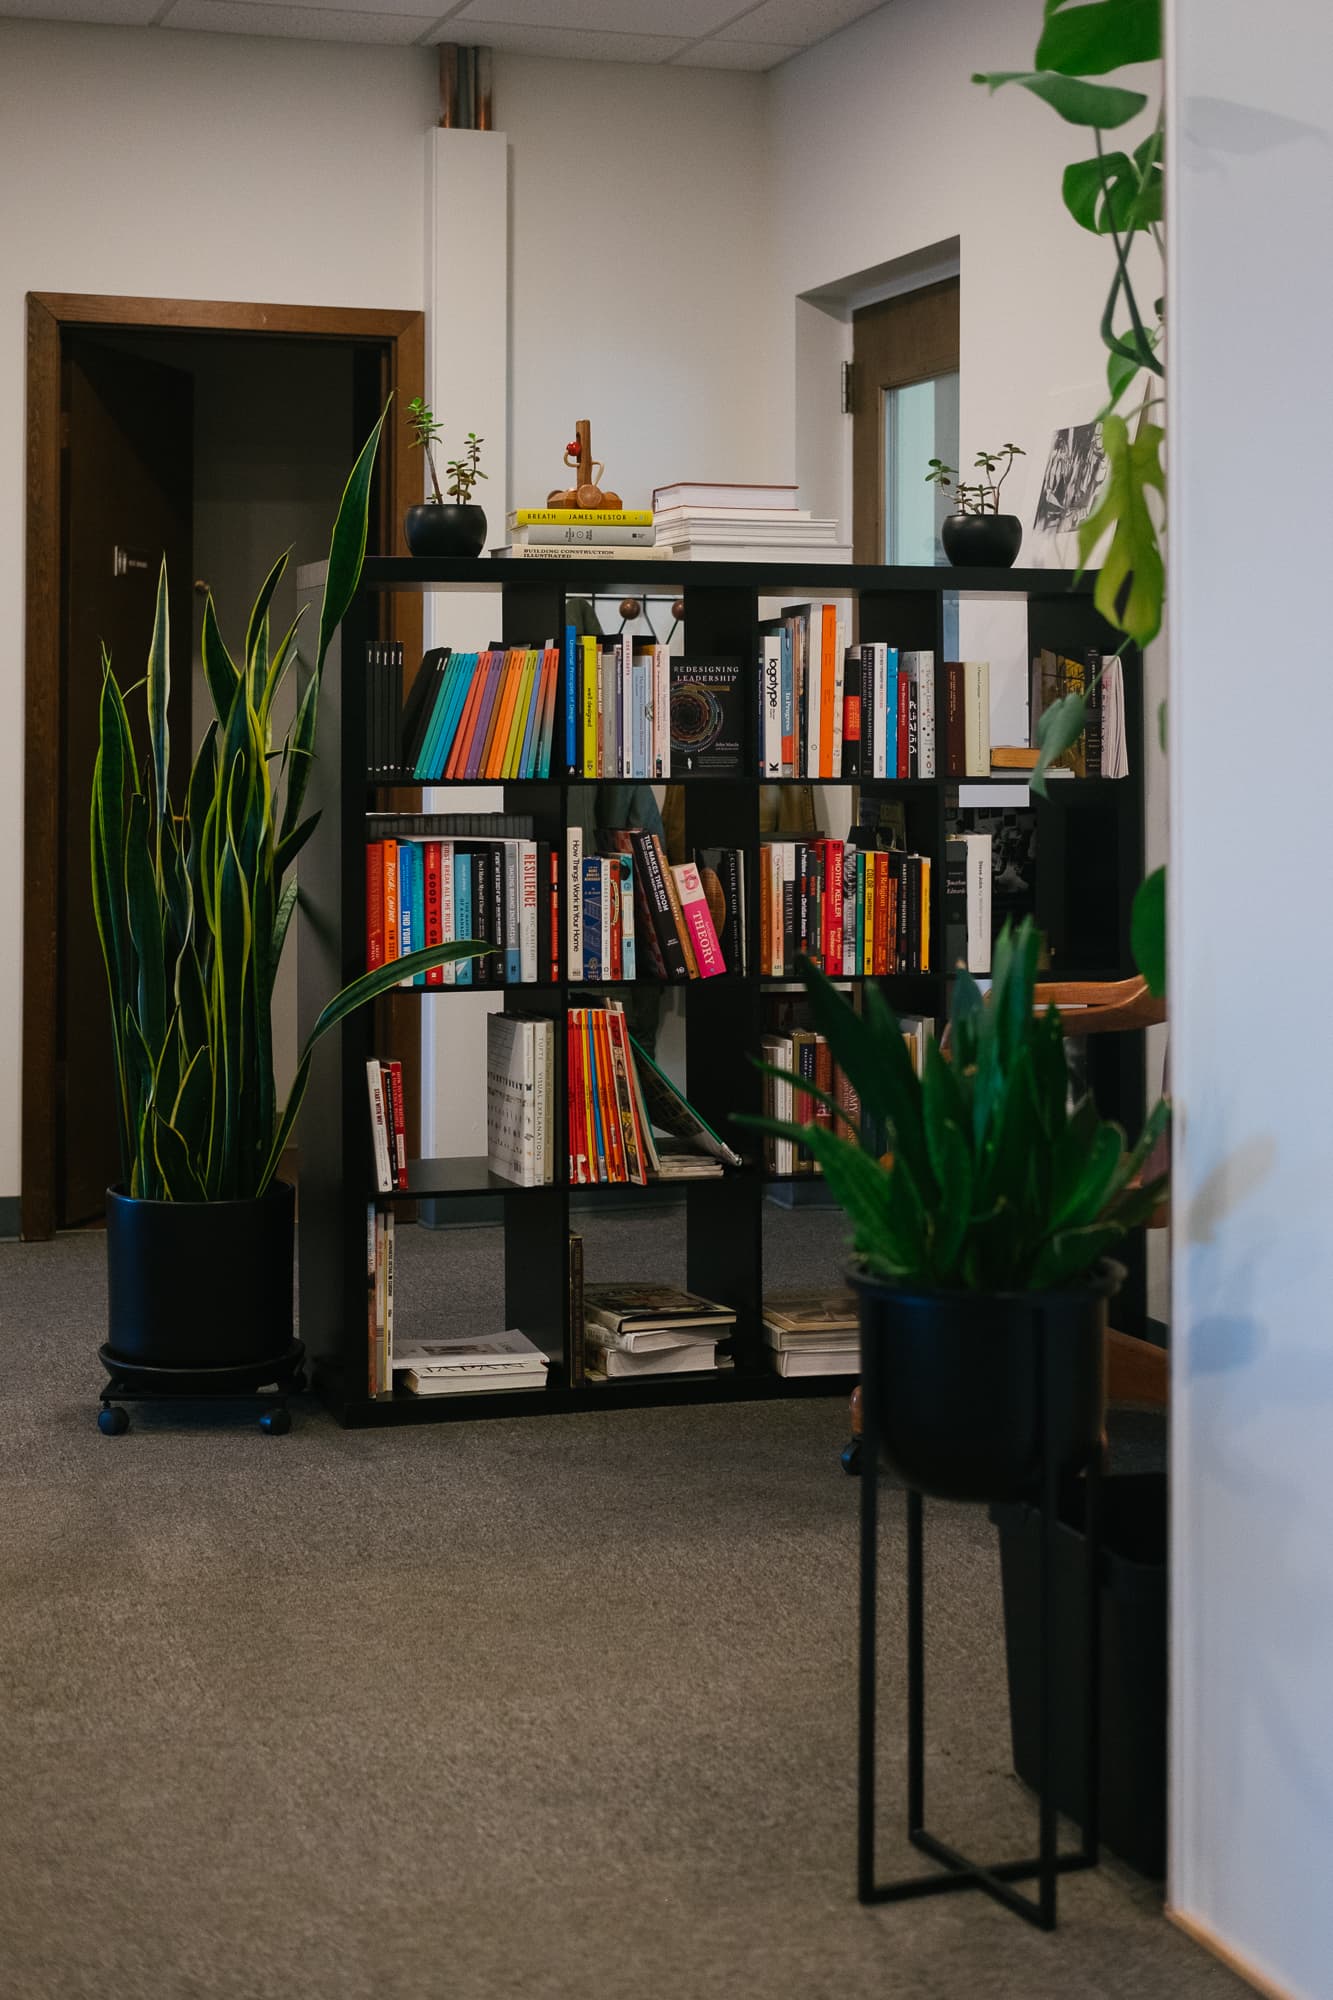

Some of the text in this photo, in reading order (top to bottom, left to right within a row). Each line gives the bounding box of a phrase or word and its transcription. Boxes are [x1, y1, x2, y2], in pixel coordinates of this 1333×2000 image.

[673, 665, 740, 673] REDESIGNING
[766, 658, 779, 707] logotype
[784, 692, 791, 700] In
[572, 840, 580, 857] How
[387, 862, 396, 892] RADICAL
[523, 854, 536, 908] RESILIENCE
[572, 860, 580, 883] Things
[644, 835, 669, 912] TILE MAKES THE ROOM
[866, 868, 874, 889] COLOR
[429, 873, 437, 905] GOOD
[572, 884, 580, 903] Work
[880, 861, 888, 907] Bad Religion
[387, 895, 396, 924] CANDOR
[402, 911, 411, 926] FIND
[429, 910, 437, 925] TO
[572, 912, 580, 928] Your
[785, 883, 793, 934] HEART AFLAME
[402, 927, 411, 945] YOUR
[572, 929, 580, 953] Home
[692, 910, 715, 965] THEORY
